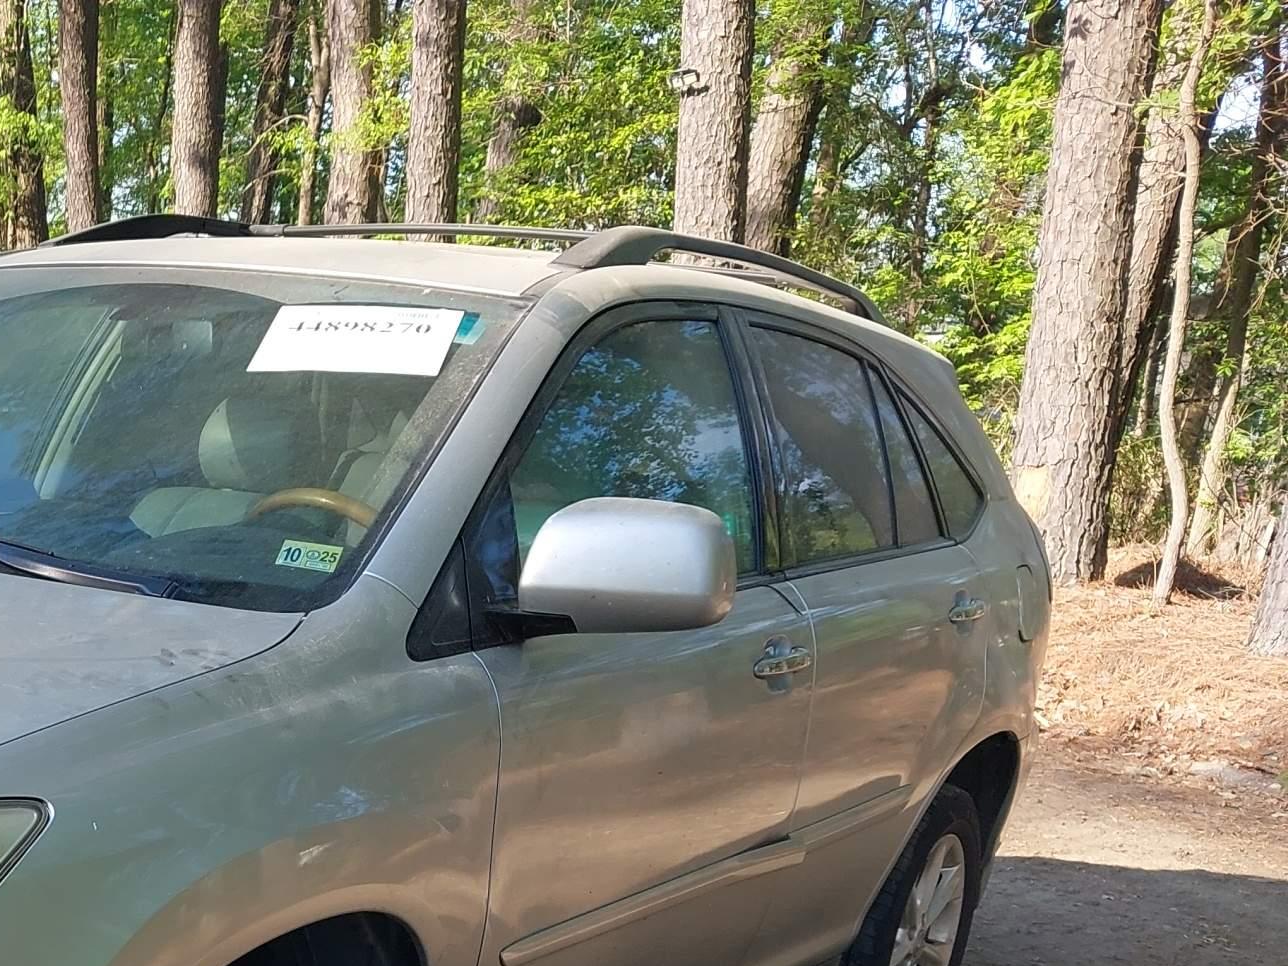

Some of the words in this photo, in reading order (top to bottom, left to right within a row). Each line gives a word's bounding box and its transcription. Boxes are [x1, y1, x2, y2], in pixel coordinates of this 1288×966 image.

[289, 320, 432, 334] 44898270
[283, 546, 302, 563] 10
[319, 550, 339, 564] 25
